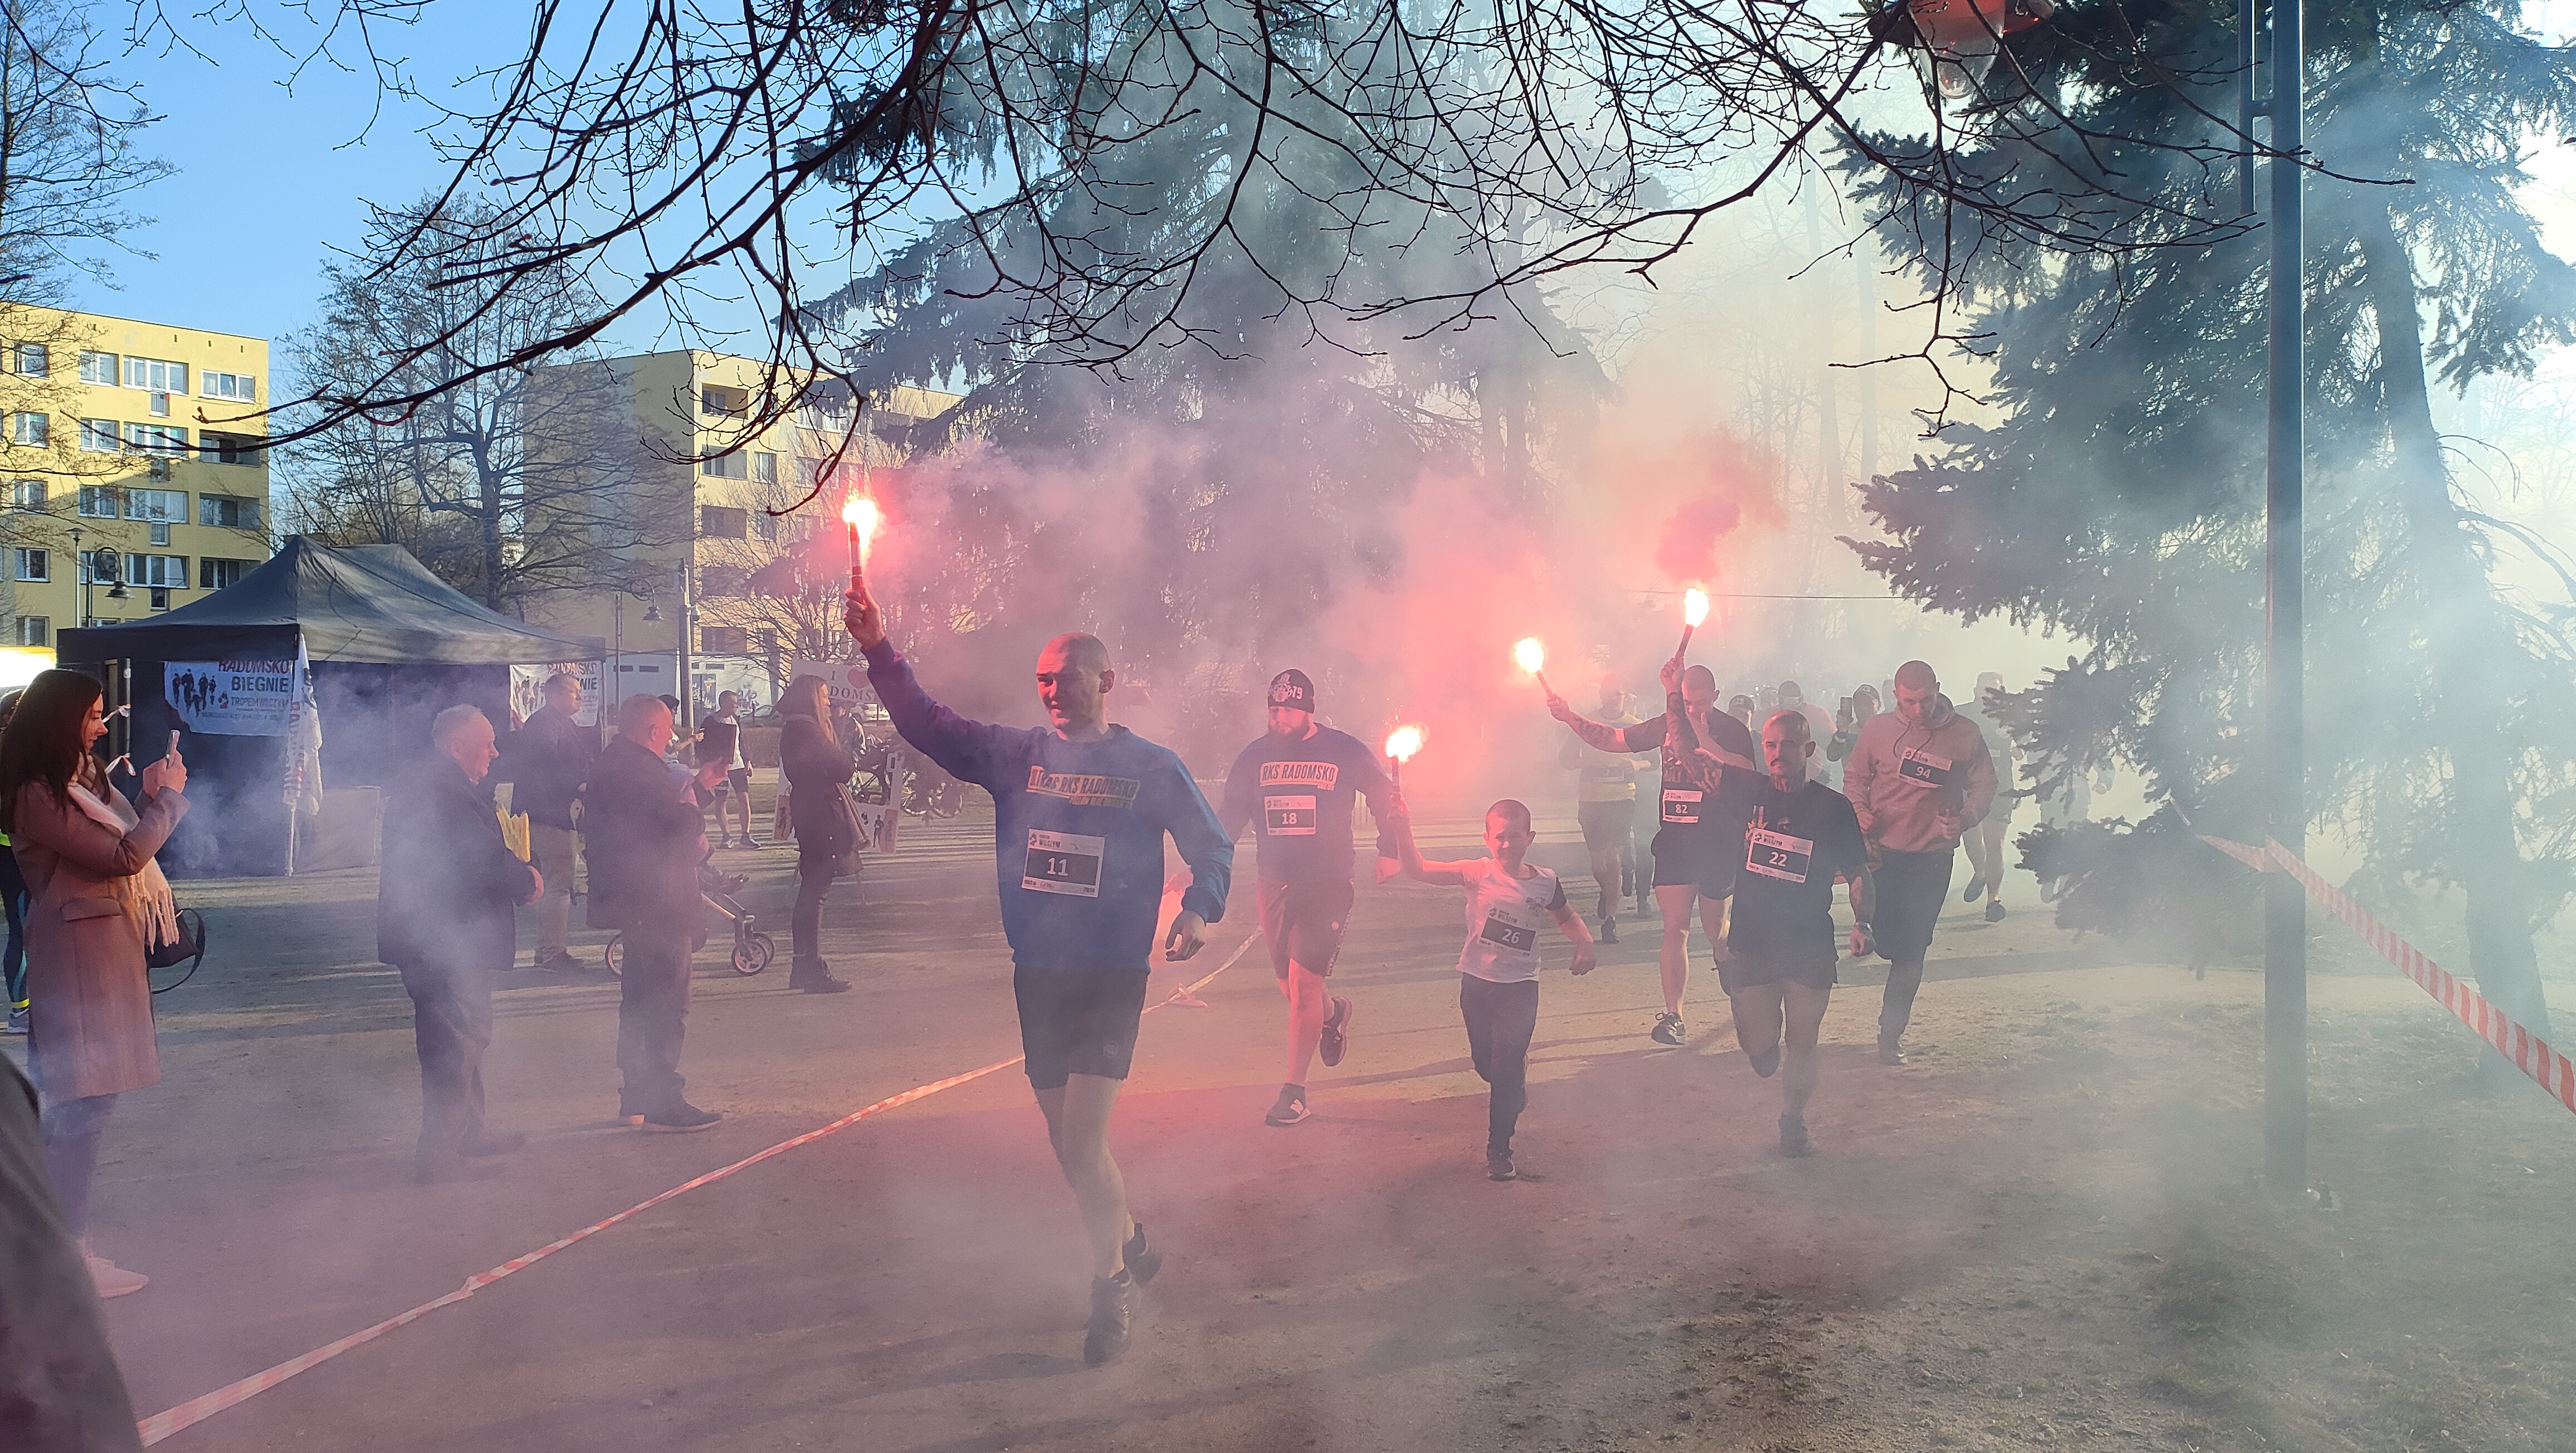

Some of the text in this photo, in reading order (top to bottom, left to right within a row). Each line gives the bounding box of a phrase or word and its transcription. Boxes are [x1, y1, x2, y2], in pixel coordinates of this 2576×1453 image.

[218, 660, 290, 674] RADOMSKO
[231, 676, 289, 693] BIEGNIE
[1262, 764, 1335, 781] RKS RADOMSKO
[1915, 766, 1931, 779] 94
[1060, 777, 1080, 794] RKS
[1080, 778, 1138, 798] RADOMSKO
[1675, 804, 1688, 813] 82
[1281, 813, 1297, 825] 18
[1047, 857, 1069, 876] 11
[1769, 851, 1788, 867] 22
[1501, 928, 1521, 944] 26
